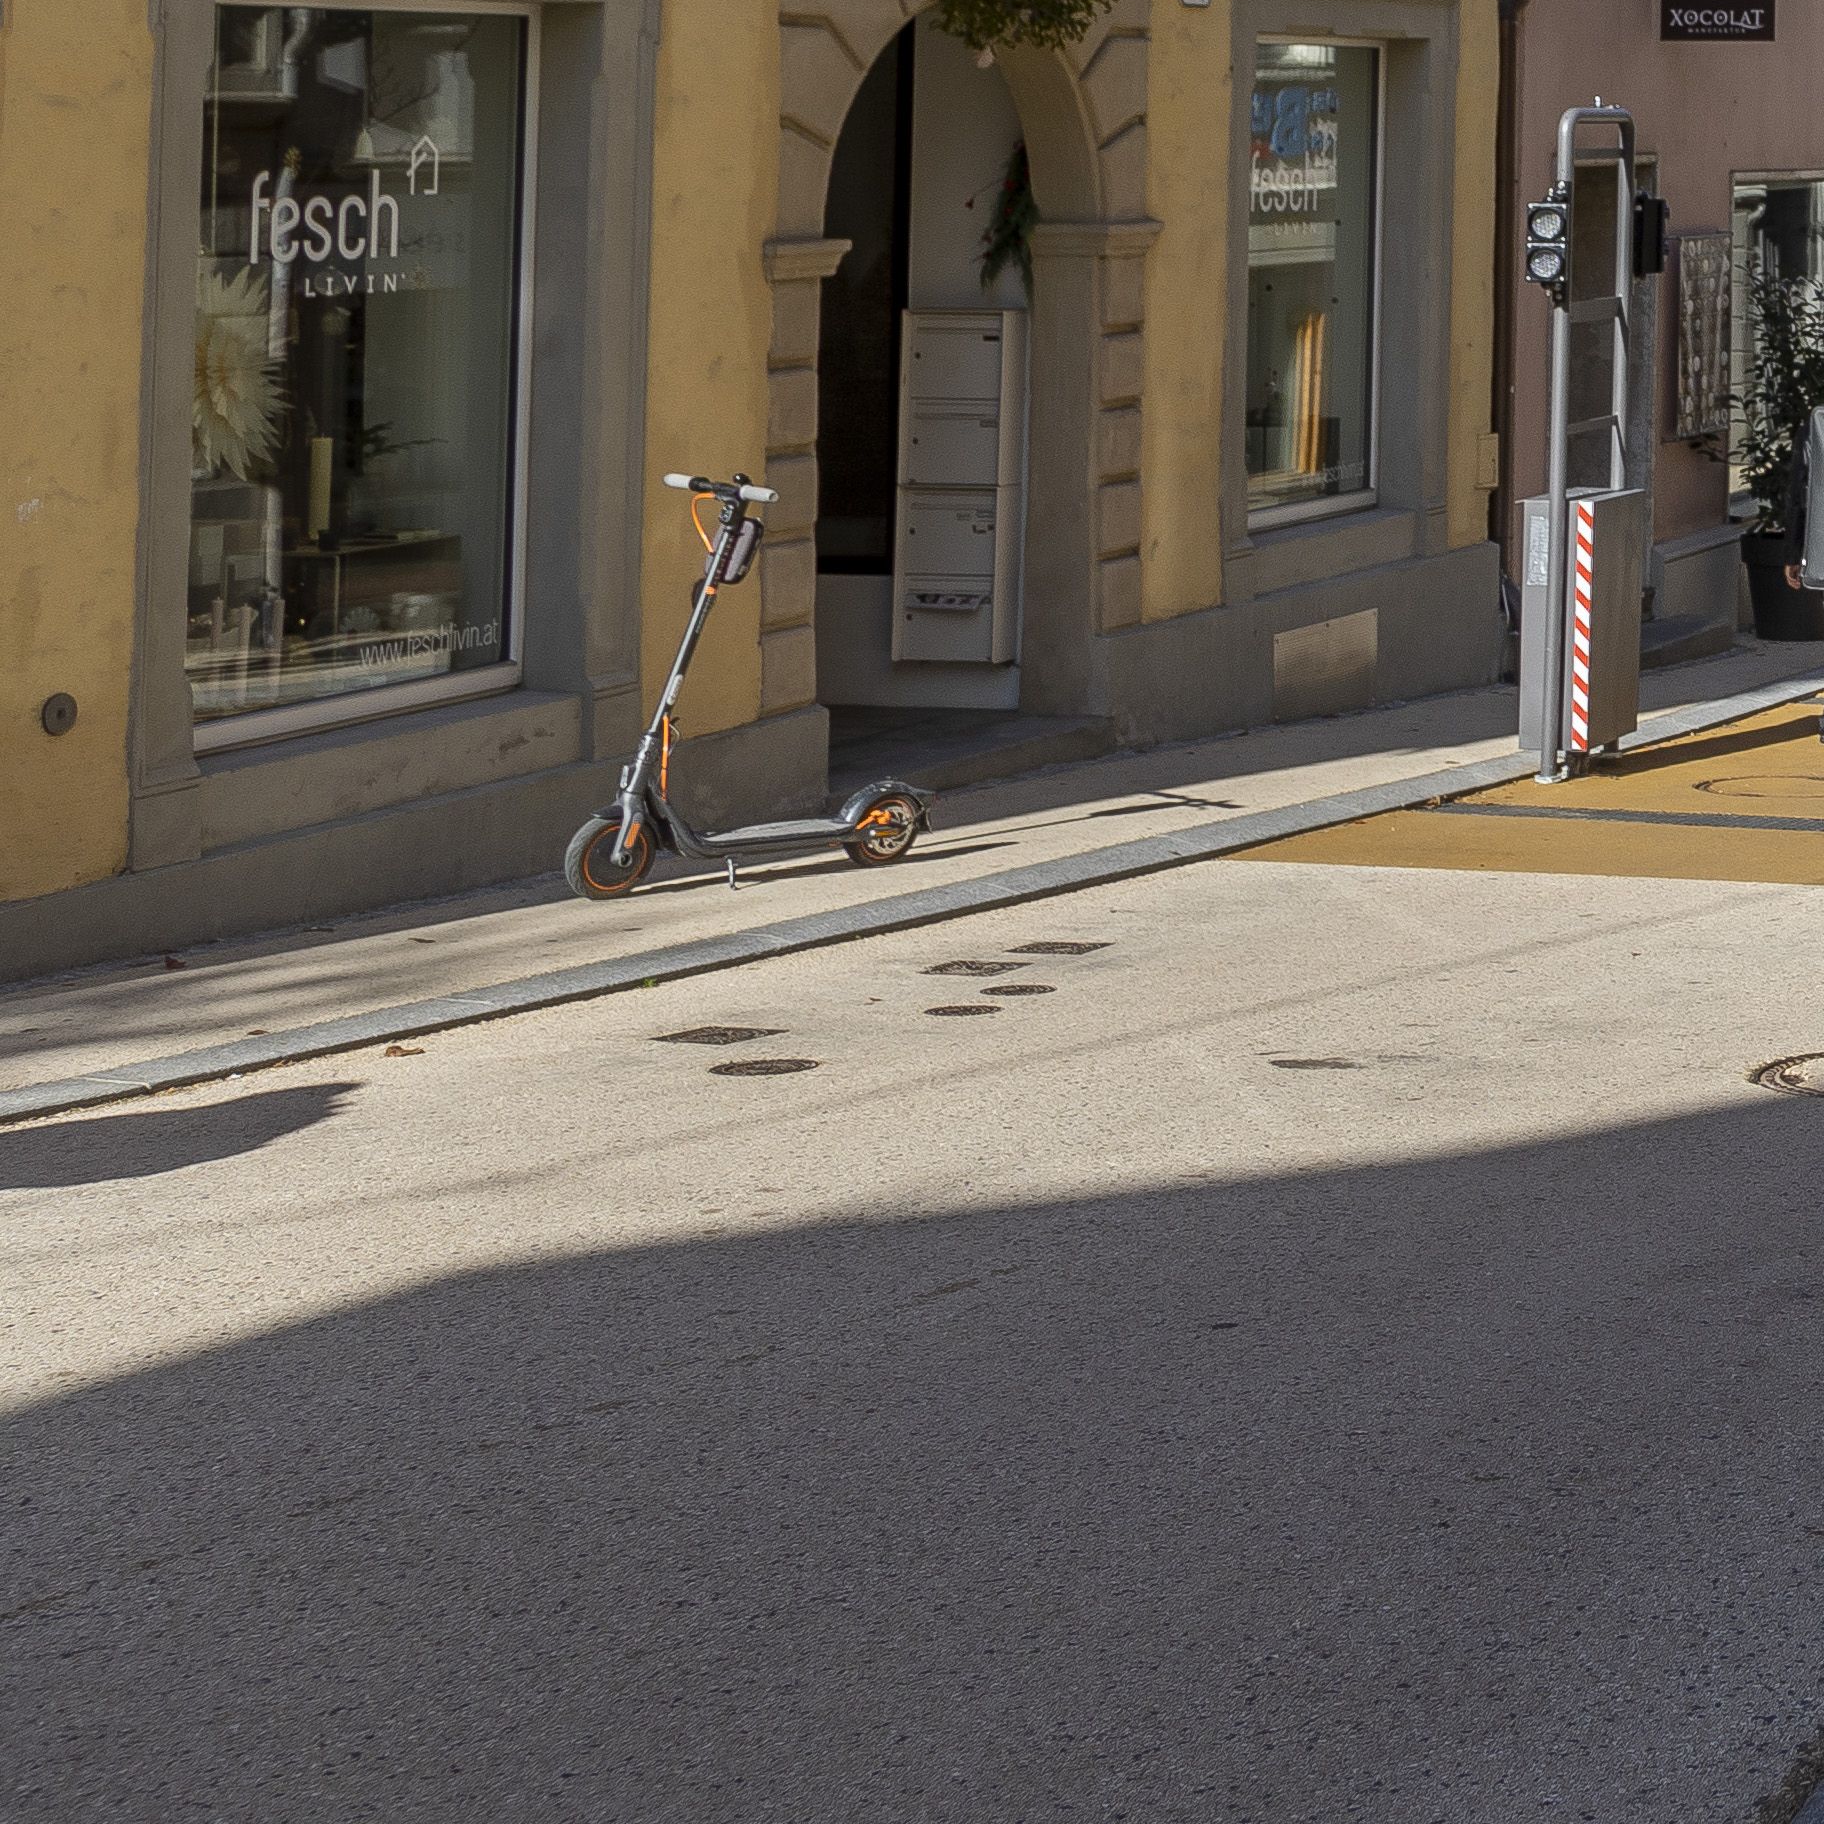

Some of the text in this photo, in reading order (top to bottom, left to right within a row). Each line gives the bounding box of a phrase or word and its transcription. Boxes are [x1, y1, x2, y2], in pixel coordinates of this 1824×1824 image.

[1669, 9, 1765, 30] XOCOLAT
[250, 169, 399, 264] fesch
[360, 618, 499, 668] www.feschlivin.at
